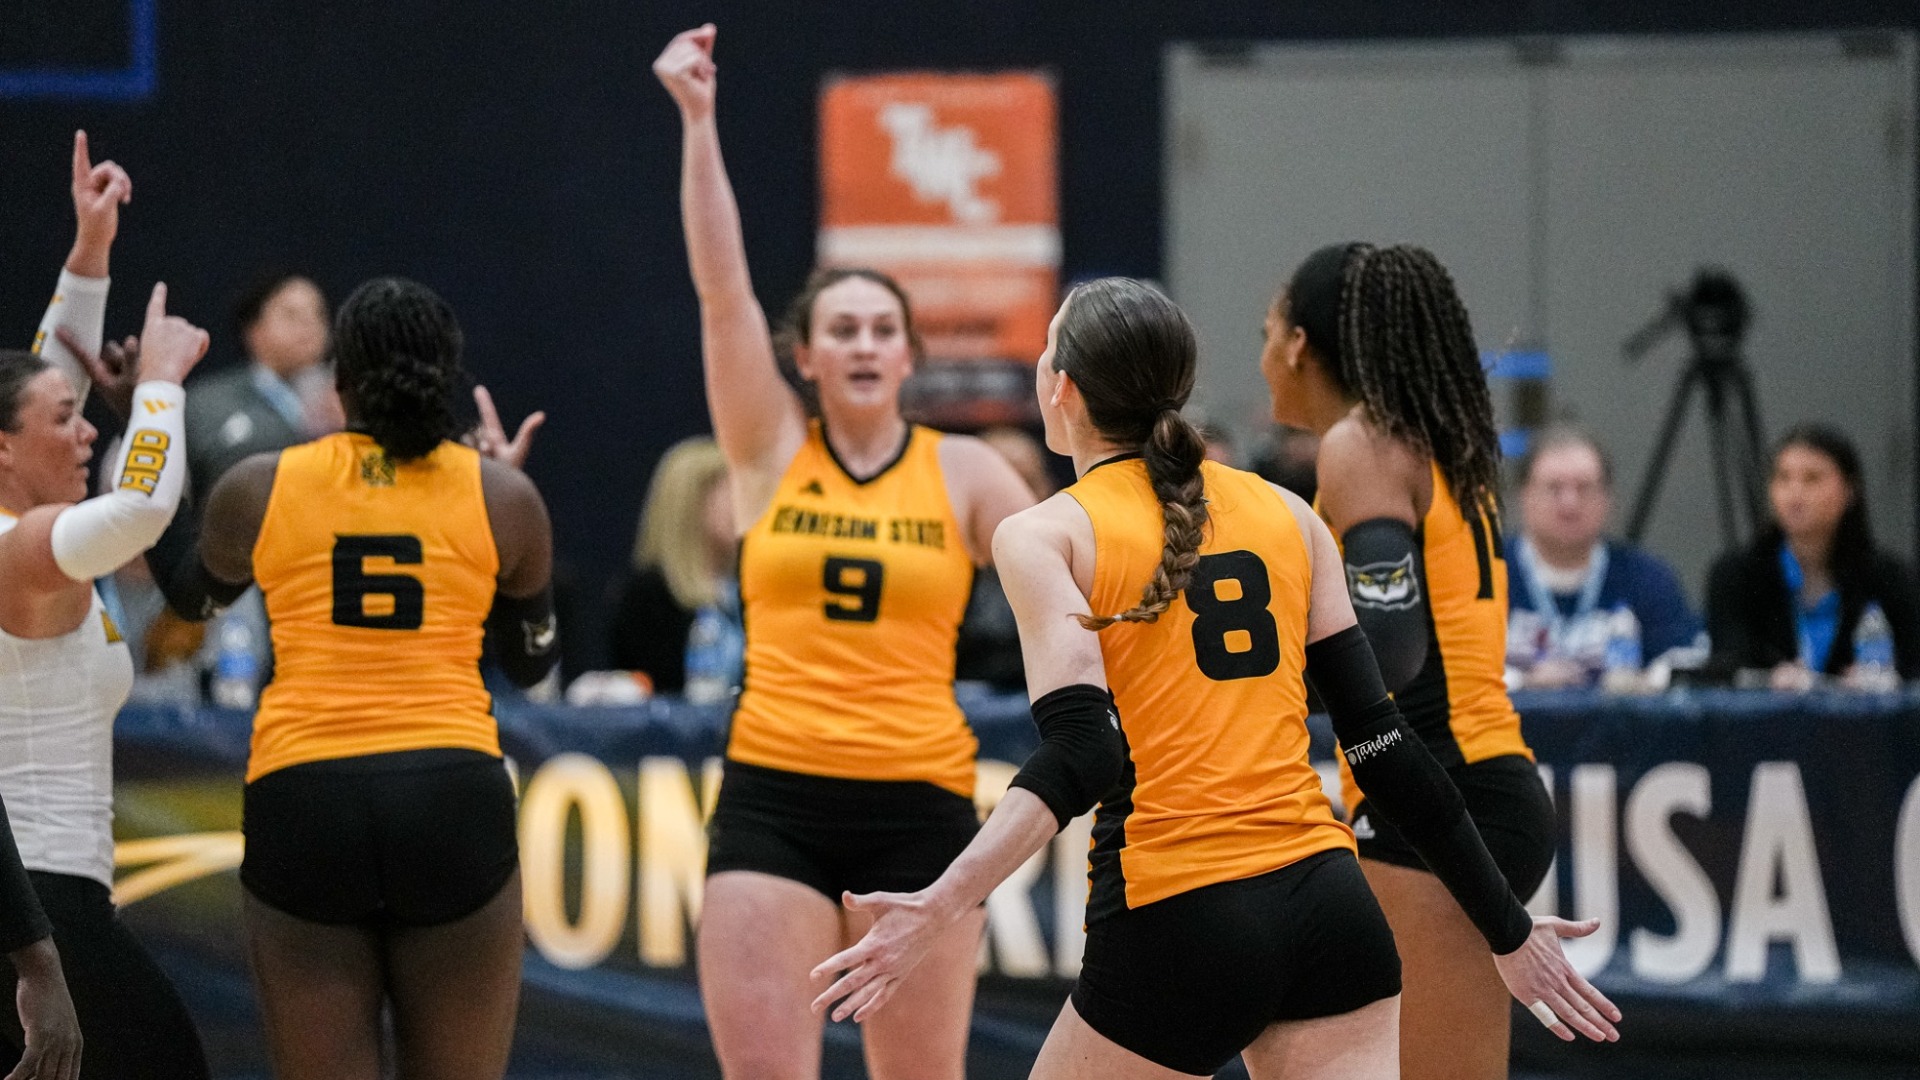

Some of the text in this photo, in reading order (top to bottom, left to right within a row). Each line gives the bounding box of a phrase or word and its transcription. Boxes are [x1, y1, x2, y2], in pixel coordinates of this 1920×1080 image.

[331, 533, 424, 630] 6
[823, 556, 883, 622] 9
[1184, 549, 1280, 681] 8
[1344, 728, 1402, 764] Tandem
[1526, 760, 1842, 986] USA
